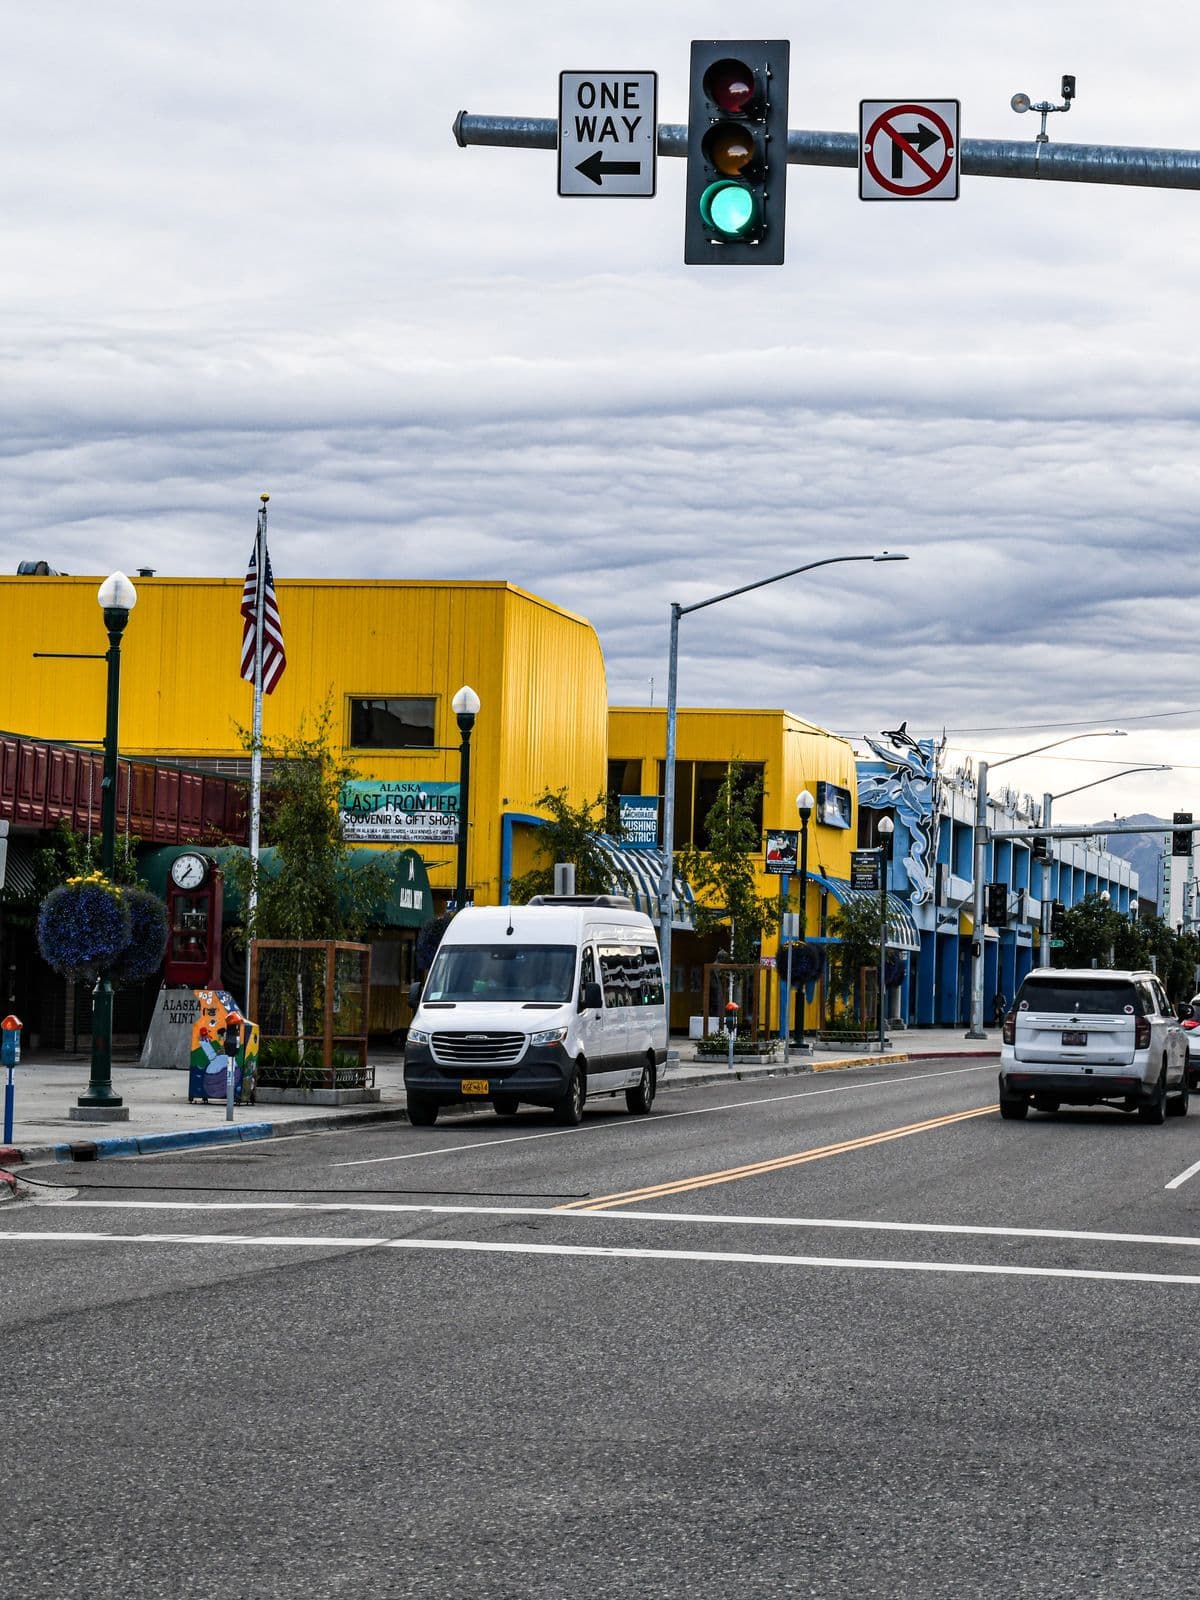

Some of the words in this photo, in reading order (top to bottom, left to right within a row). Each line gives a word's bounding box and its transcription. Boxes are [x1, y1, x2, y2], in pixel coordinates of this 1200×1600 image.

[577, 82, 639, 109] ONE
[575, 116, 642, 144] WAY
[380, 783, 421, 793] ALASKA
[343, 794, 382, 812] LAST
[386, 794, 457, 812] FRONTIER
[343, 815, 392, 825] SOUVENIR
[394, 815, 402, 825] &
[405, 815, 426, 825] GIFT
[429, 815, 457, 826] SHOP
[621, 820, 656, 831] MUSHING
[162, 1000, 202, 1011] ALASKA
[169, 1012, 195, 1024] MINT
